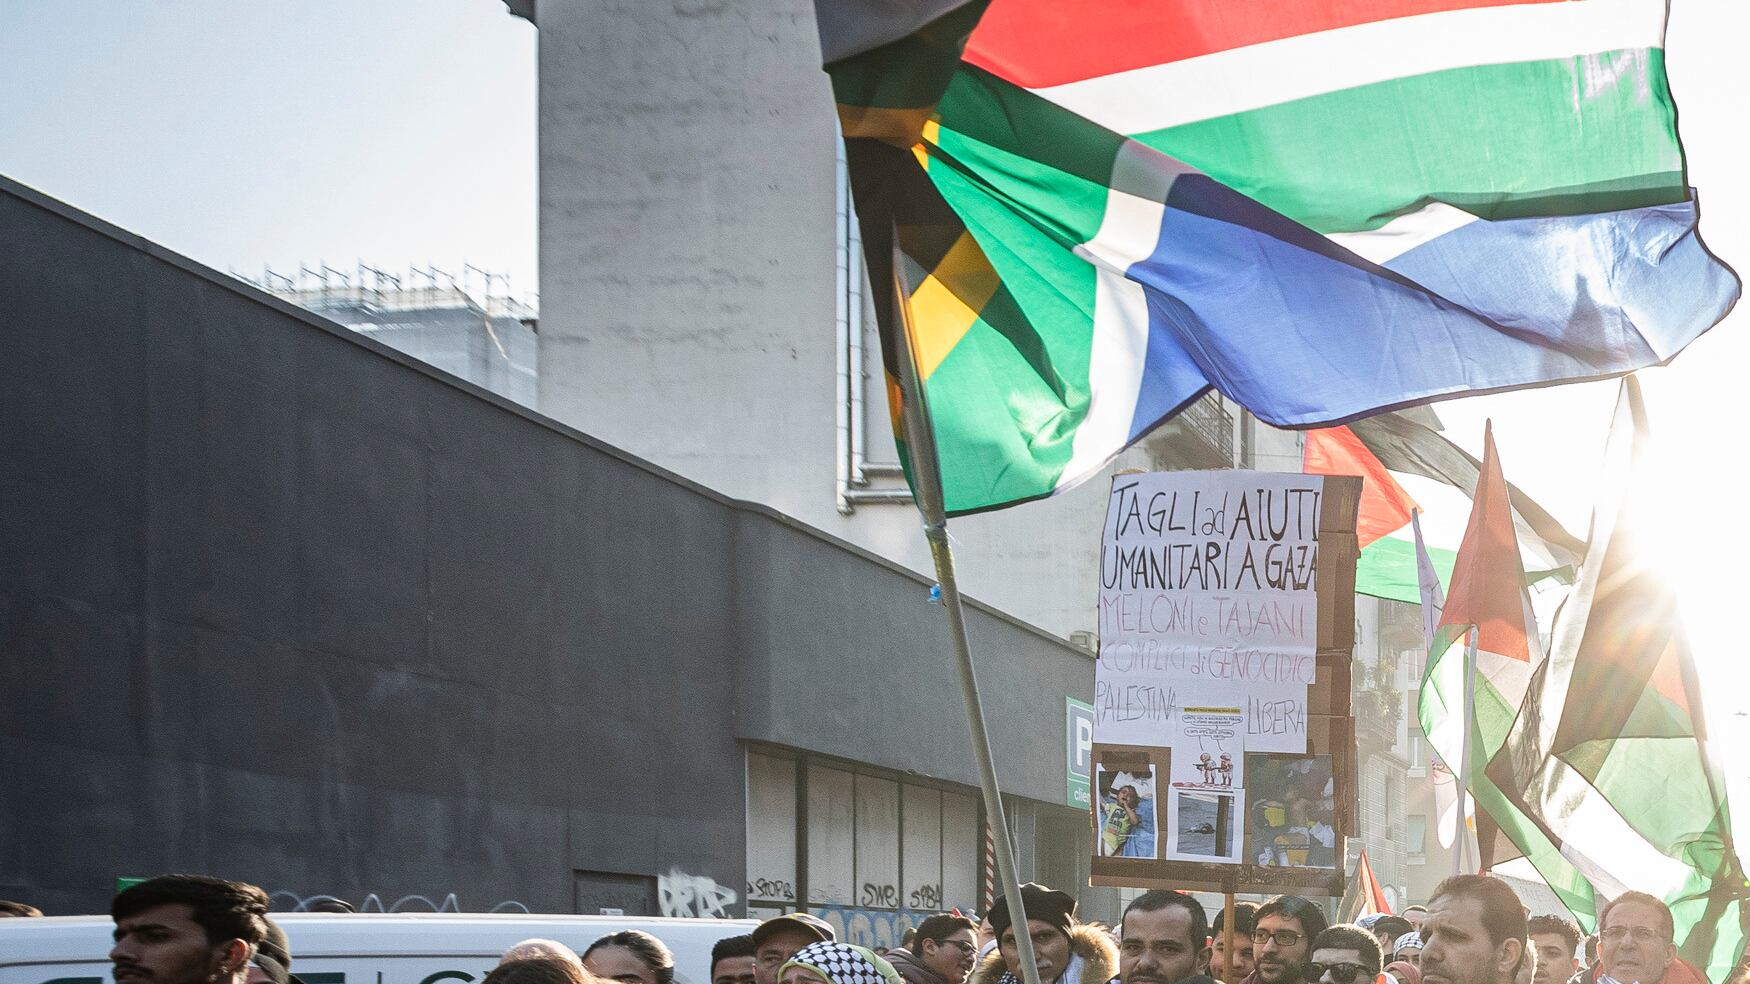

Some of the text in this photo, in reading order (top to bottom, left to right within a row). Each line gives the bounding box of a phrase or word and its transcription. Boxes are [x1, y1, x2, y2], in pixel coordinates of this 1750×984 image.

[1113, 481, 1320, 542] TAGLI ad AIUTI
[1102, 541, 1318, 591] UMANITARI A GAZA
[1103, 593, 1195, 636] MELONI
[1212, 596, 1305, 640] TAJANI
[1101, 638, 1186, 673] COMPLICI
[1208, 646, 1315, 685] GENOCIDIO
[1096, 680, 1305, 736] PALESTINA LIBERA
[1076, 716, 1093, 766] P
